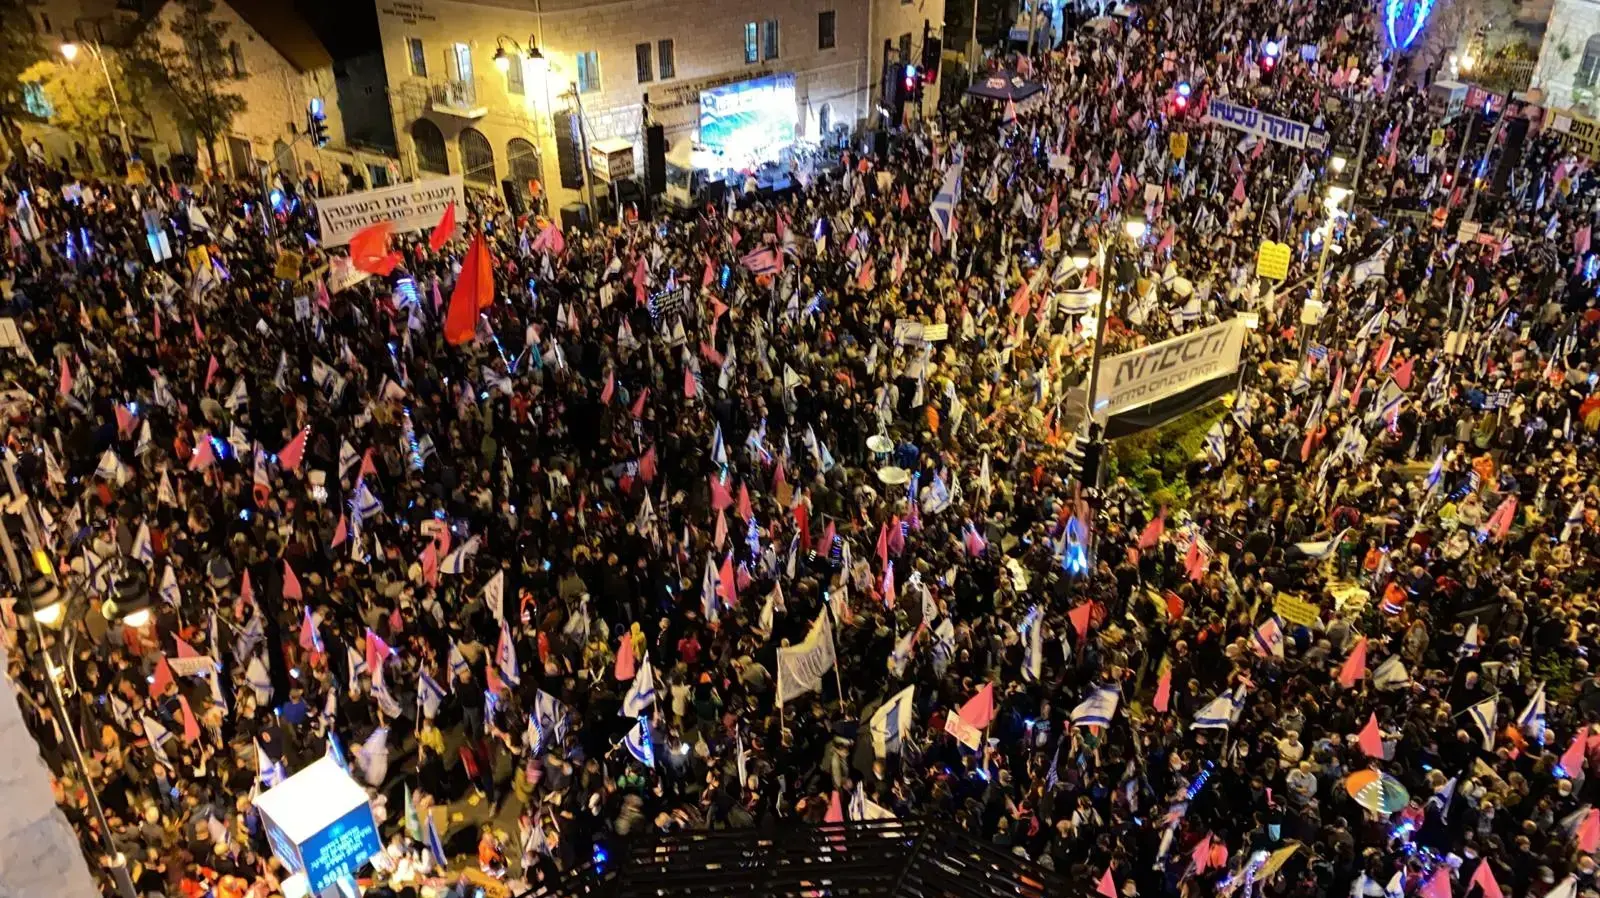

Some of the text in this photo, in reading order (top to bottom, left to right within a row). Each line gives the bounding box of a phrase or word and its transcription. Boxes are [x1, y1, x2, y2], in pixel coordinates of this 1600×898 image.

[1261, 115, 1305, 142] חוקה
[327, 186, 456, 219] משנים את השיטה
[334, 216, 367, 232] חוקה
[369, 207, 414, 224] כותבים
